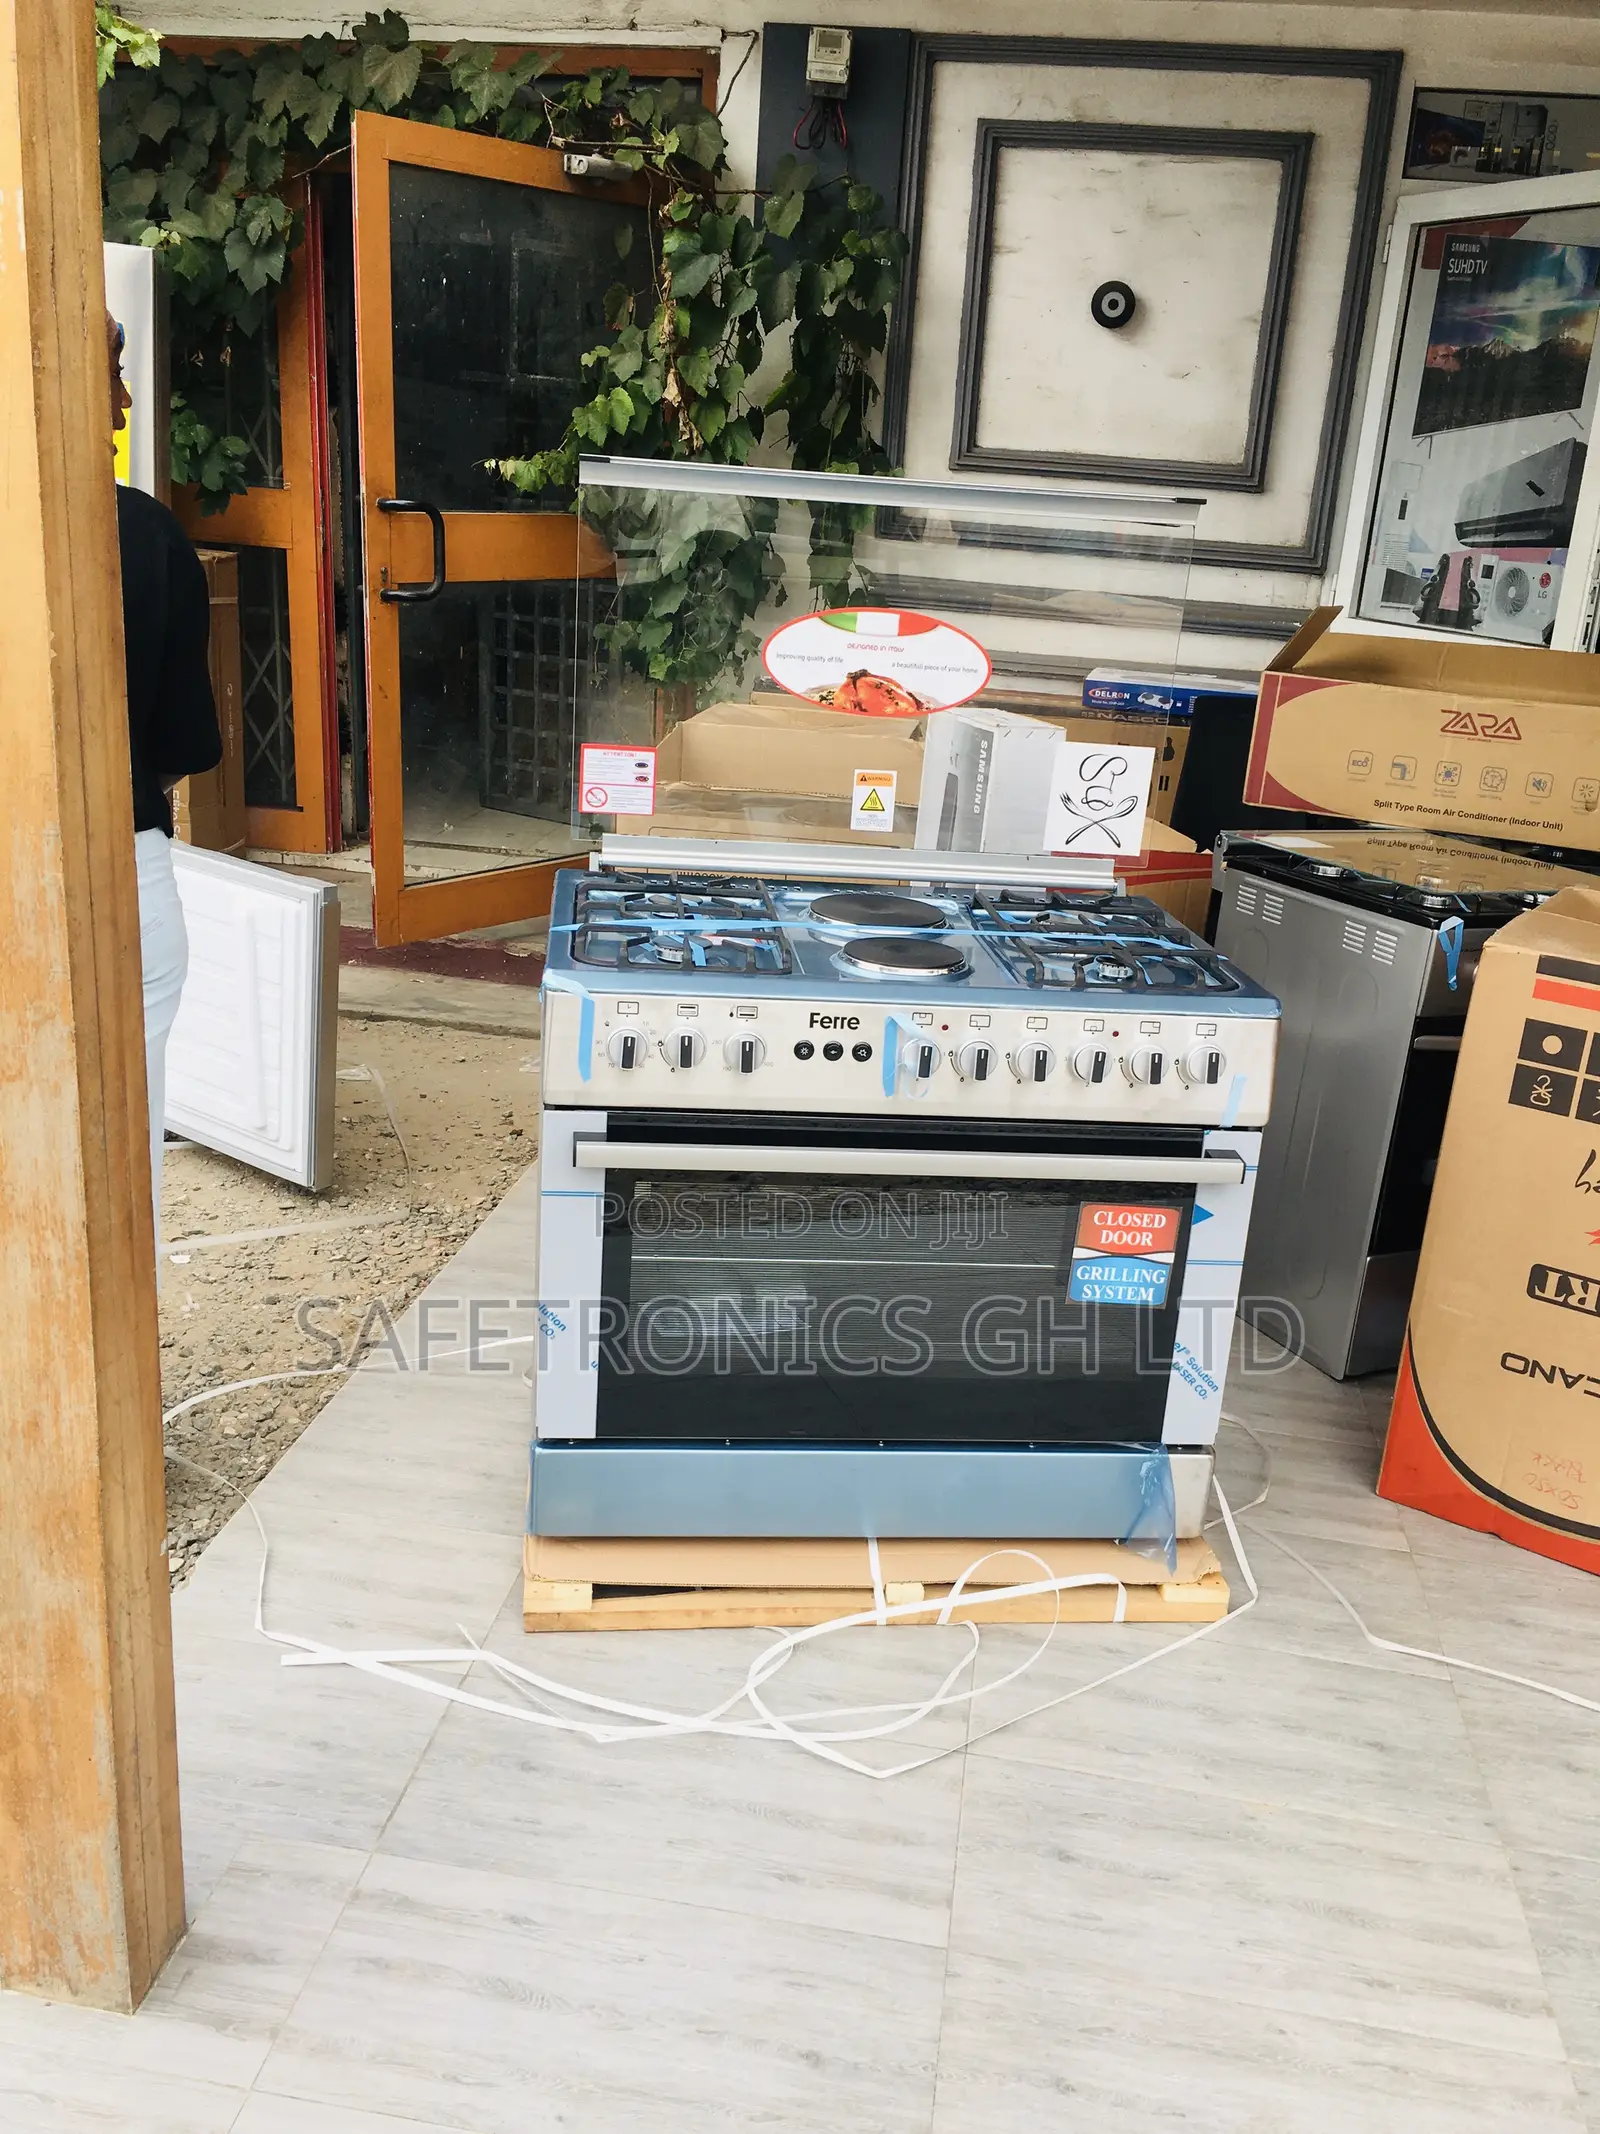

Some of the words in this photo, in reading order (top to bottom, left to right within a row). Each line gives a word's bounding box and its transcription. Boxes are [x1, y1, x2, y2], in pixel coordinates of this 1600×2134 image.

[1451, 243, 1480, 253] SAMSUNG
[1537, 590, 1548, 599] LG
[806, 655, 826, 663] quality
[962, 666, 978, 674] home
[1095, 690, 1131, 699] DELRON
[1440, 709, 1522, 740] ZARA
[974, 740, 988, 814] SAMSUNG
[1373, 799, 1393, 809] Split
[1394, 802, 1415, 812] Type
[1416, 804, 1441, 815] Room
[1442, 808, 1456, 817] Air
[1457, 810, 1508, 824] Conditioner
[1509, 816, 1541, 828] (Indoor
[1542, 820, 1564, 832] Unit)
[809, 1012, 860, 1030] Ferre
[1093, 1210, 1167, 1228] CLOSED
[1100, 1229, 1153, 1247] DOOR
[1076, 1265, 1167, 1284] GRILLING
[1082, 1284, 1155, 1301] SYSTEM
[1186, 1356, 1219, 1393] Solution
